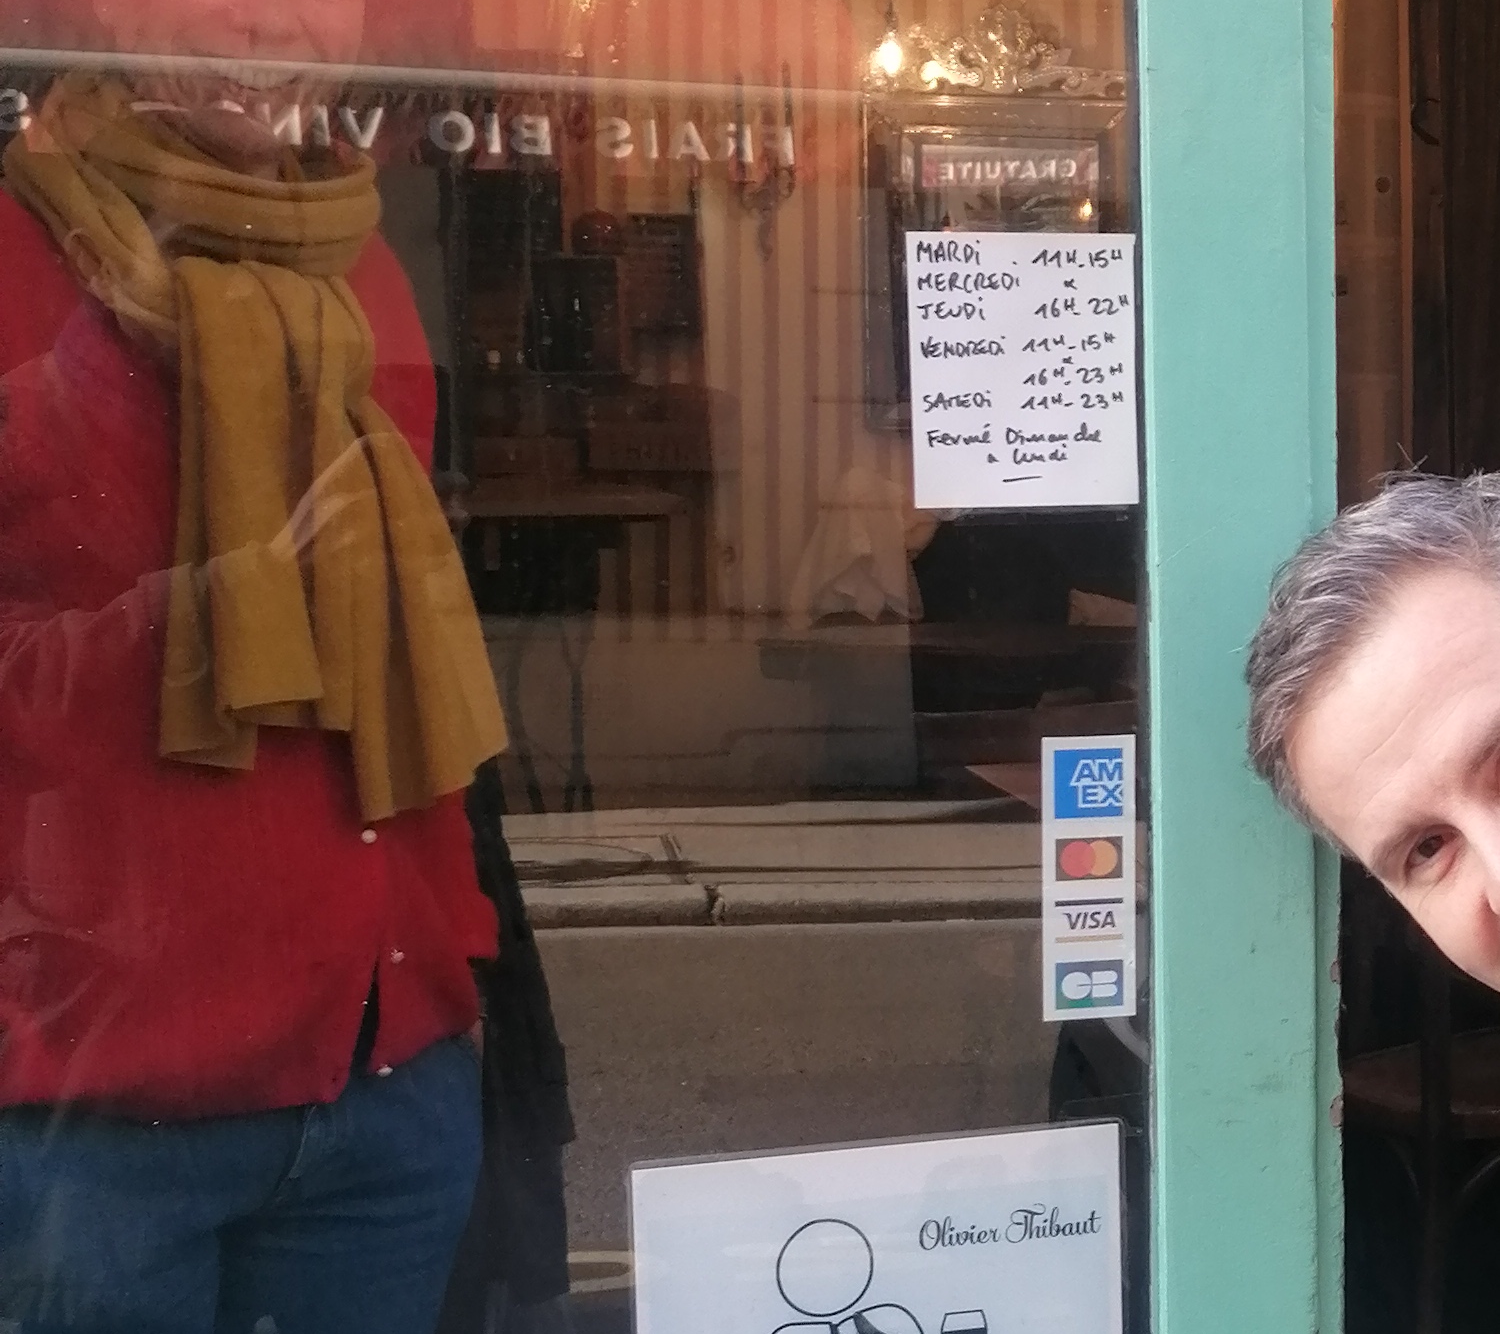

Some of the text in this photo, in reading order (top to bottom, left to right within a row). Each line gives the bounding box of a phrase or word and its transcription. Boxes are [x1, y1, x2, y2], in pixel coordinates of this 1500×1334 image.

[1070, 758, 1123, 786] AM
[1077, 782, 1123, 809] EX
[1063, 911, 1116, 930] VISA
[919, 1202, 1102, 1252] Olivier Thibaut
